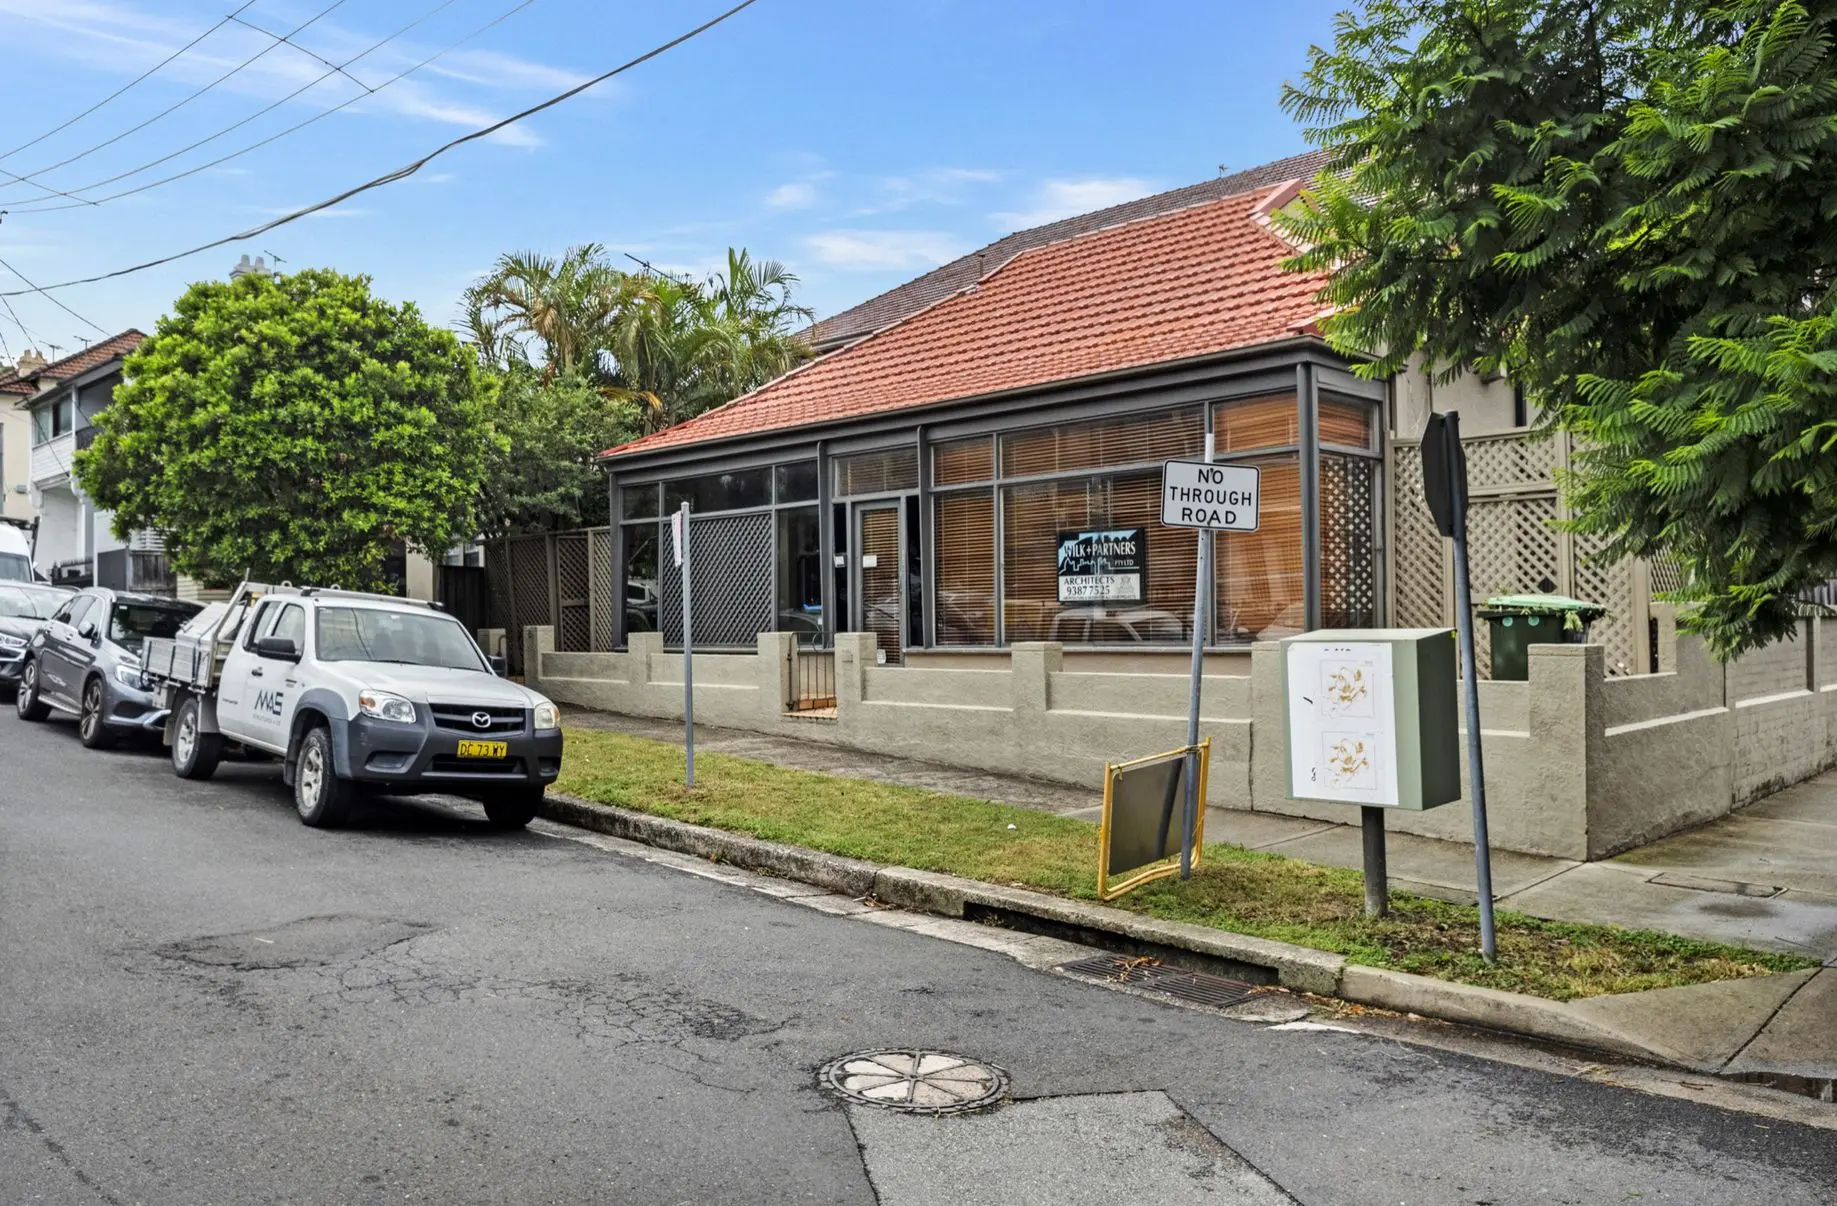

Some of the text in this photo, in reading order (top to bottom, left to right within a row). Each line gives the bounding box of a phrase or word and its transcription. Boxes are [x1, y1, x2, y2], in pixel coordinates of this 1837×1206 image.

[1198, 468, 1224, 485] NO
[1169, 486, 1252, 507] THROUGH
[1181, 507, 1237, 525] ROAD
[1064, 576, 1115, 585] ARCHITECTS
